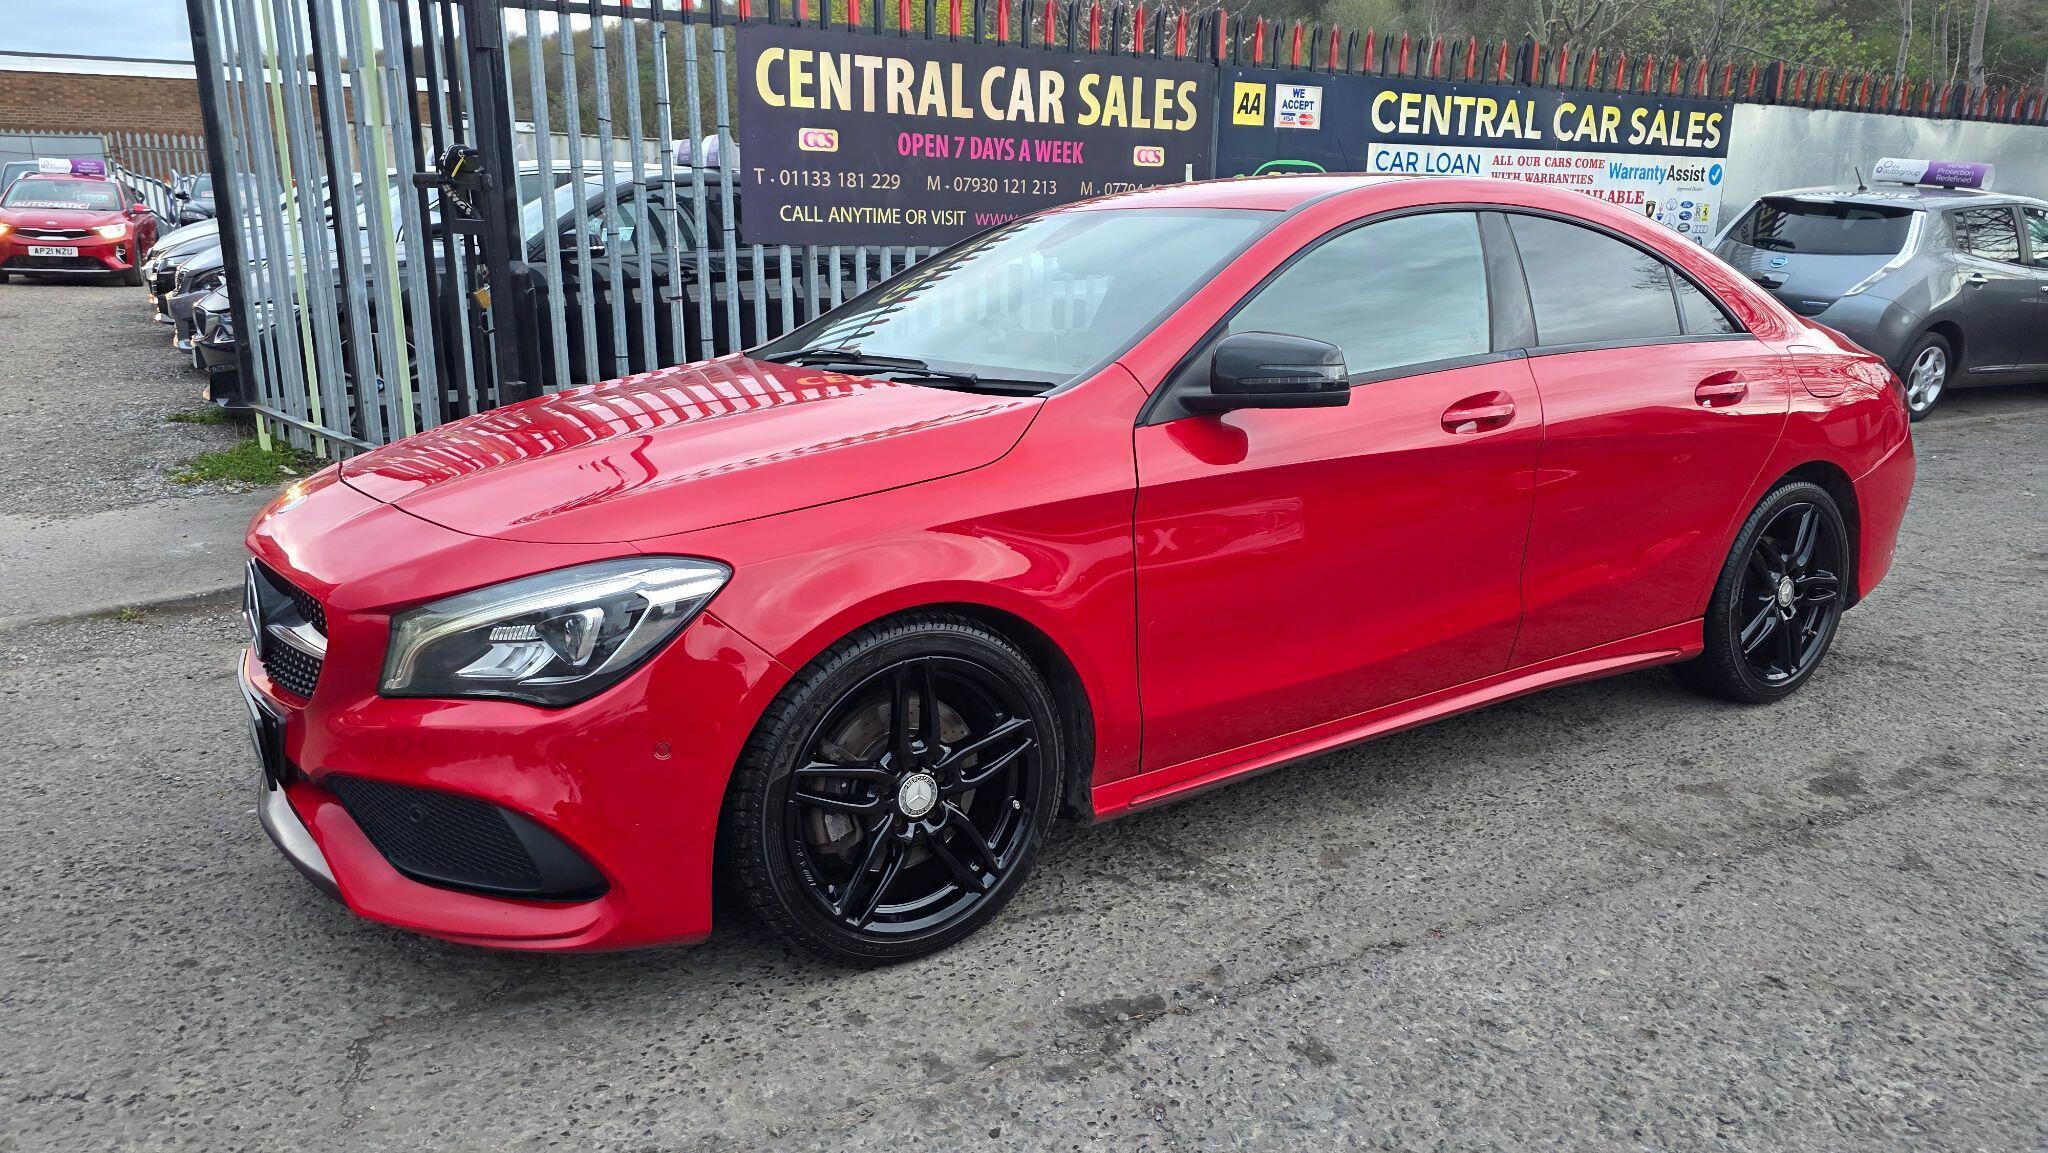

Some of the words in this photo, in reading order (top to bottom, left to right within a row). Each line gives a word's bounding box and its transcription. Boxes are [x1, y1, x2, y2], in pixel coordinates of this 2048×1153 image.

[755, 47, 974, 119] CENTRAL
[980, 66, 1065, 125] CAR
[1077, 73, 1198, 131] SALES
[1293, 88, 1305, 98] WE
[1237, 92, 1261, 115] AA
[1282, 100, 1314, 110] ACCEPT
[1371, 90, 1542, 140] CENTRAL
[1553, 102, 1621, 144] CAR
[1628, 107, 1723, 149] SALES
[898, 131, 949, 158] OPEN
[954, 136, 966, 159] 7
[970, 137, 1015, 161] DAYS
[1018, 139, 1031, 162] A
[1034, 140, 1084, 164] WEEK
[1375, 150, 1419, 172] CAR
[1425, 152, 1481, 174] LOAN
[1492, 155, 1513, 166] ALL
[1517, 156, 1541, 167] OUR
[1544, 156, 1572, 169] CARS
[1575, 158, 1605, 169] COME
[779, 170, 831, 187] 01133
[838, 172, 864, 188] 181
[870, 174, 901, 190] 229
[1491, 171, 1521, 181] WITH
[1524, 172, 1594, 185] WARRANTIES
[1936, 174, 1972, 184] Redefined
[1937, 167, 1975, 177] Protection
[953, 177, 998, 193] 07930
[1004, 178, 1026, 194] 121
[1032, 180, 1057, 195] 213
[11, 201, 86, 209] AUTOMATIC
[1570, 188, 1645, 205] ILABLE
[779, 204, 823, 222] CALL
[828, 206, 901, 224] ANYTIME
[905, 209, 927, 225] OR
[930, 210, 967, 226] VISIT
[34, 247, 54, 255] AP21
[55, 248, 73, 256] NZU
